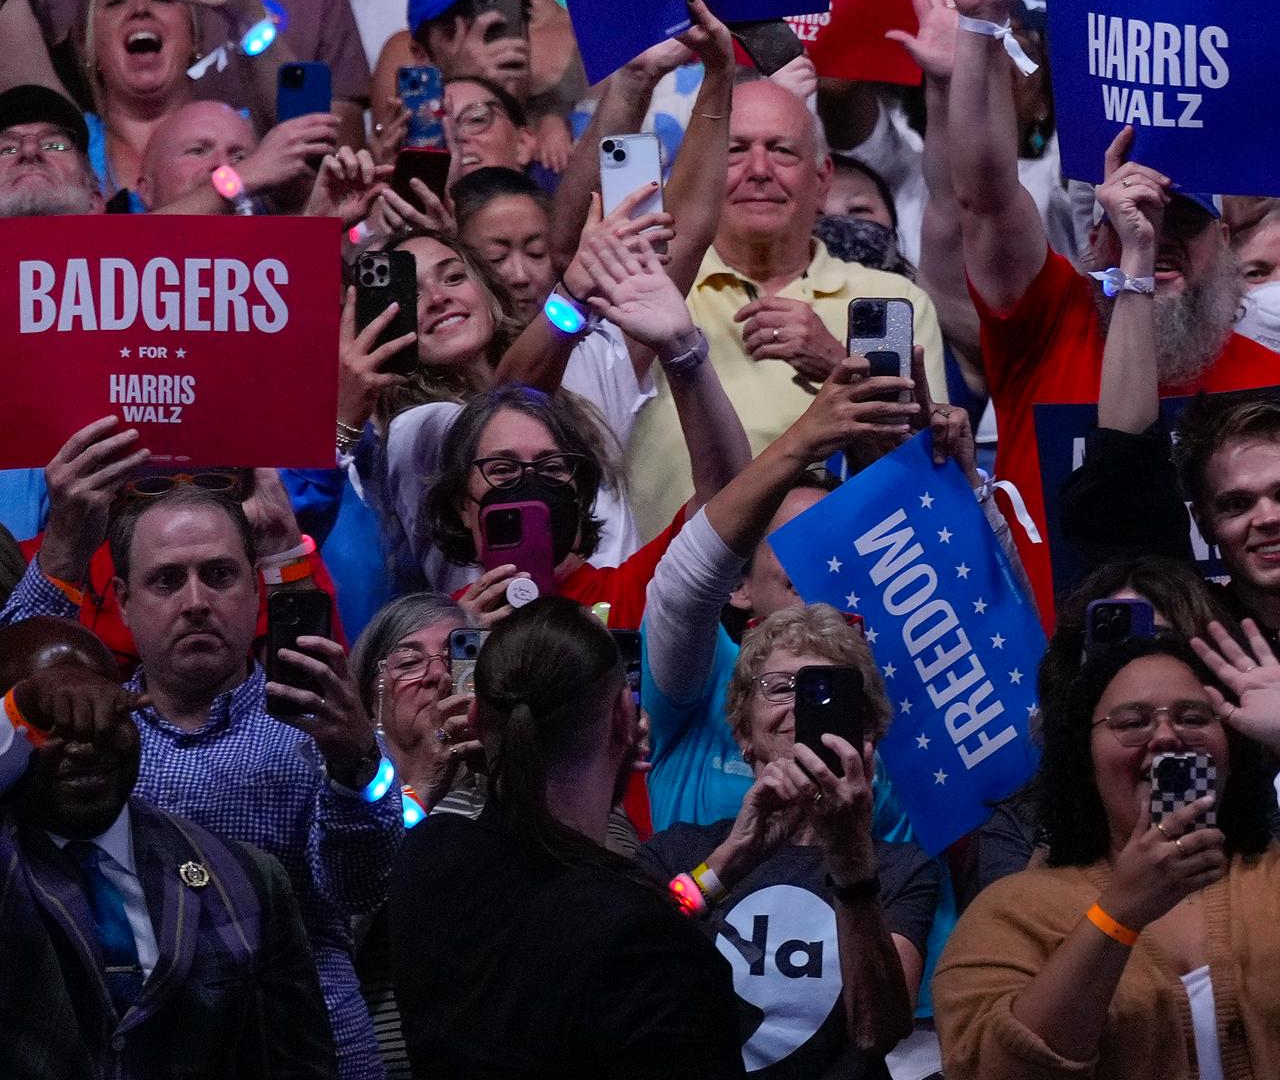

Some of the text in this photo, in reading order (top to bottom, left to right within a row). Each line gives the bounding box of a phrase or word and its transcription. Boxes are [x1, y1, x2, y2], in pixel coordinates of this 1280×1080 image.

[1087, 11, 1231, 89] HARRIS
[1101, 84, 1204, 129] WALZ
[18, 257, 290, 334] BADGERS
[138, 346, 168, 359] FOR
[109, 374, 196, 405] HARRIS
[122, 406, 182, 424] WALZ
[853, 508, 1019, 771] FREEDOM
